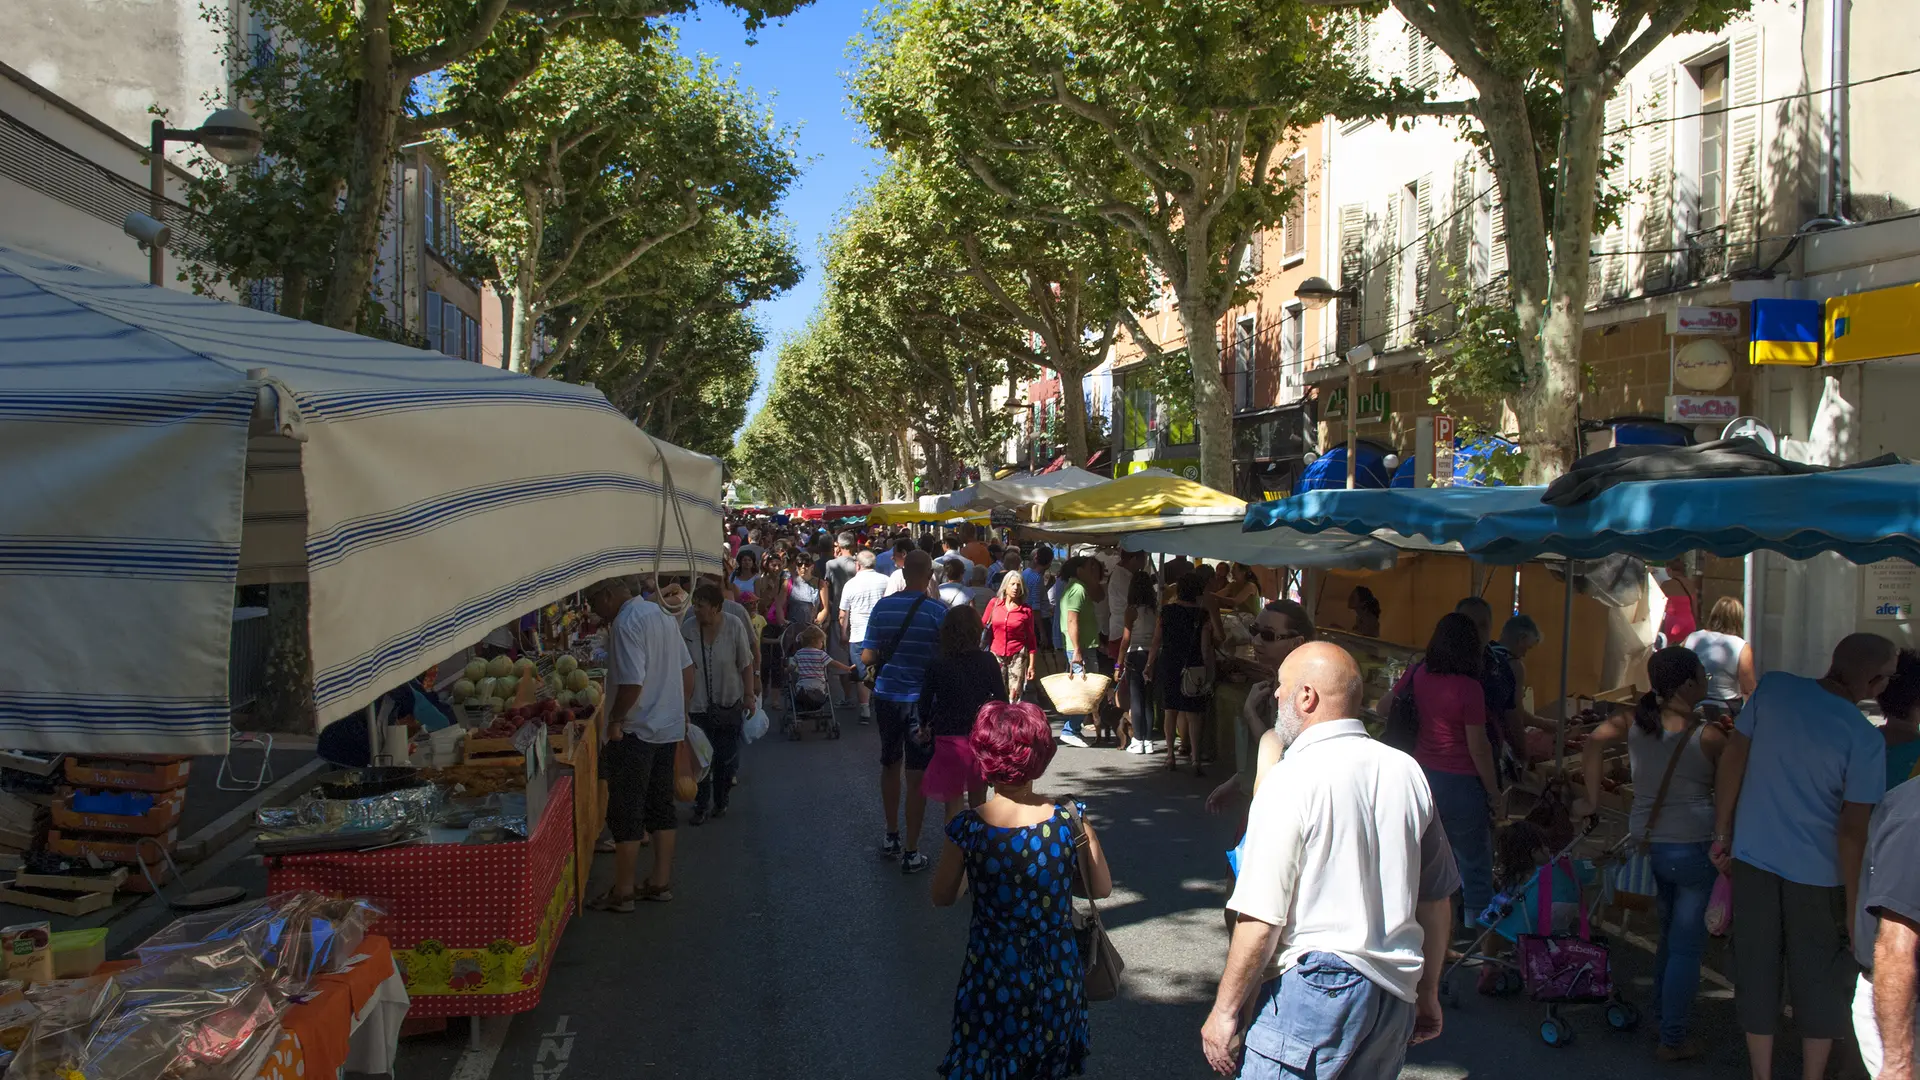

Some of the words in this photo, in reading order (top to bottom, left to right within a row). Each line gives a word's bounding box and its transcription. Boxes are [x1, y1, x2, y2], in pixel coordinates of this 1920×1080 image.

[1324, 381, 1390, 425] Chrly
[1439, 419, 1450, 441] P
[1876, 603, 1900, 615] afer
